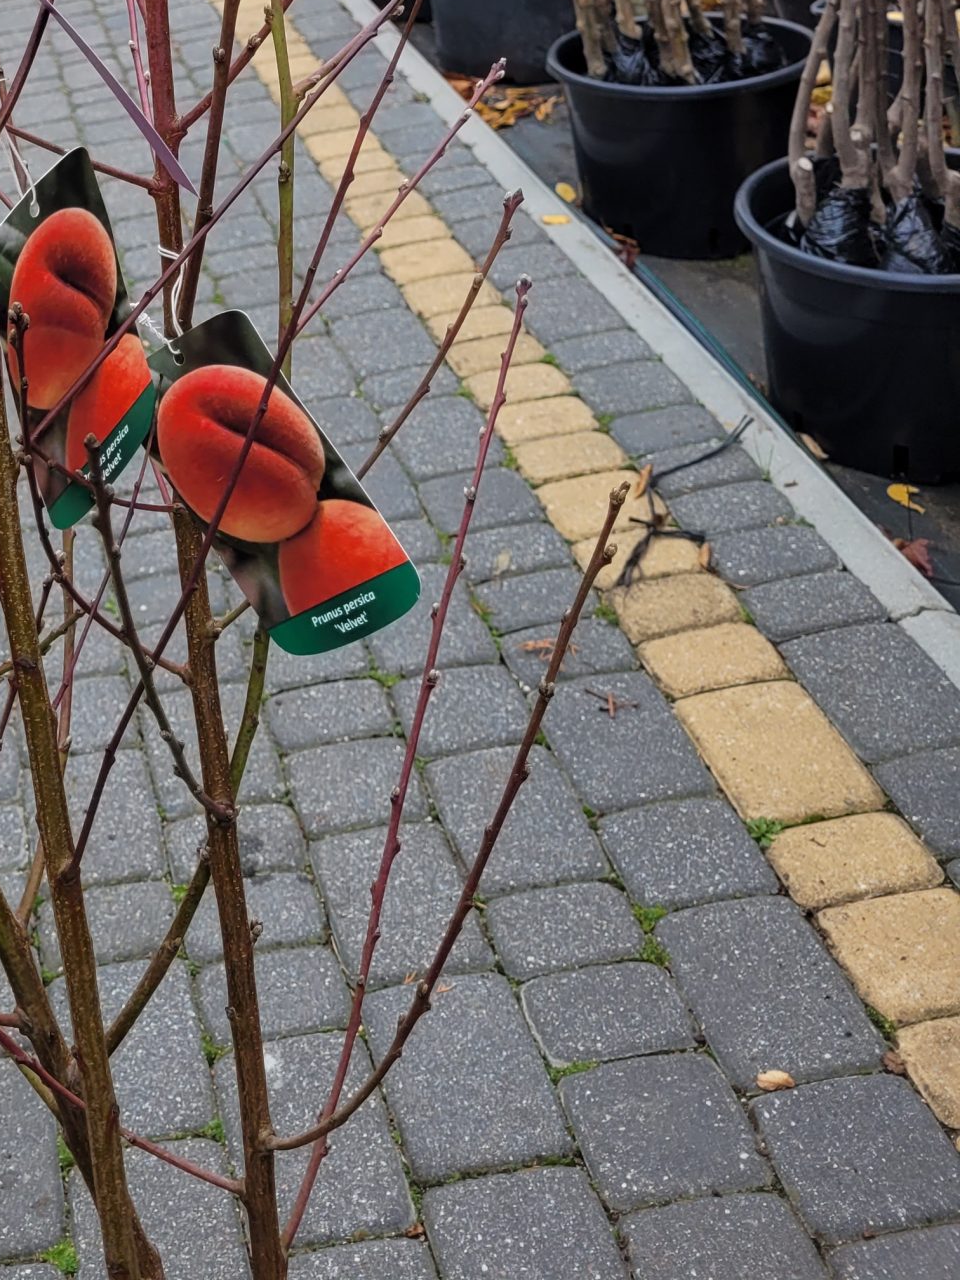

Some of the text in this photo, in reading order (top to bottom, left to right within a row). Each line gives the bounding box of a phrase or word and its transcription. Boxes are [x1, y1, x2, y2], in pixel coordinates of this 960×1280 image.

[106, 424, 129, 459] persica
[311, 590, 376, 627] Prunus persica
[334, 612, 369, 634] 'Velvet'
